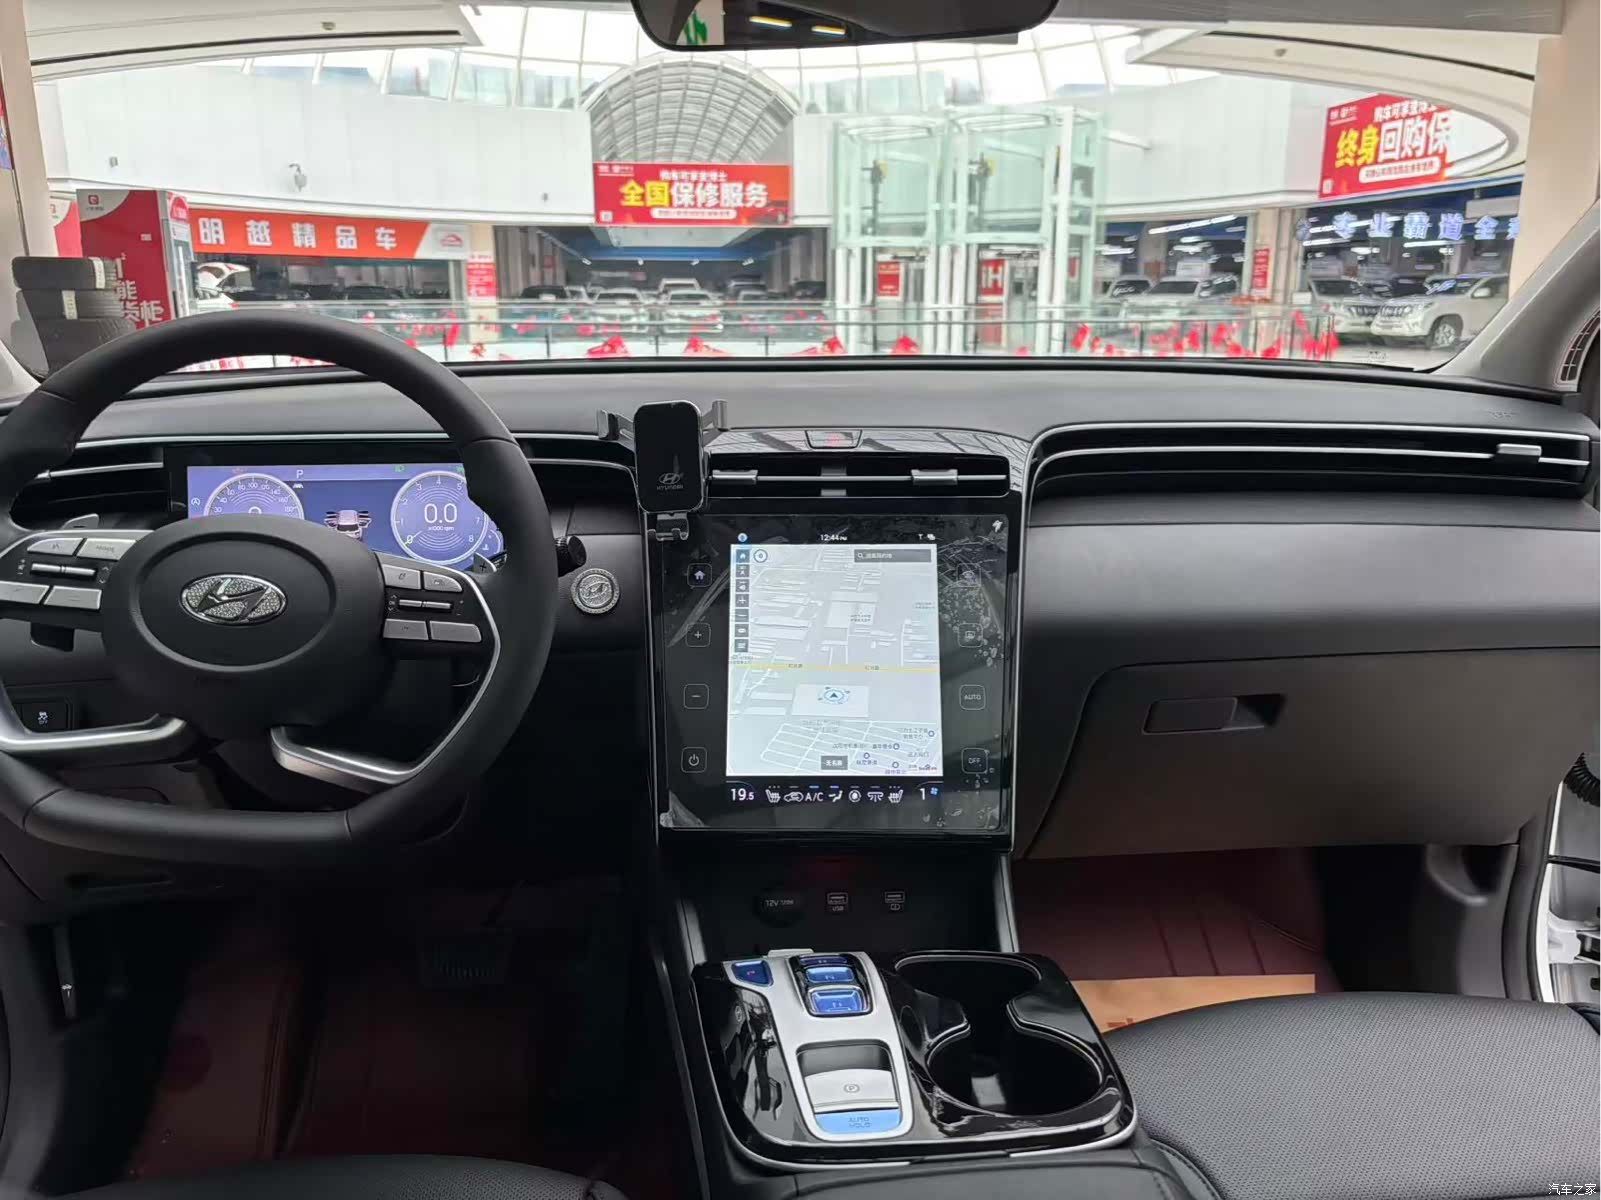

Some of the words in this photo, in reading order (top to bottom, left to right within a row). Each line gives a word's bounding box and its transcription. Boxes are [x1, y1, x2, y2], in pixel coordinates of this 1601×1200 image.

[619, 179, 768, 208] 全国保修服务
[199, 217, 397, 250] 明越精品车
[296, 469, 304, 479] P
[424, 503, 457, 523] 0.0
[468, 534, 474, 543] 8
[820, 533, 839, 541] 12:44
[964, 693, 982, 701] AUTO
[968, 756, 981, 765] OFF
[730, 788, 755, 801] 19.5
[804, 791, 824, 802] A/C
[919, 788, 926, 800] 1
